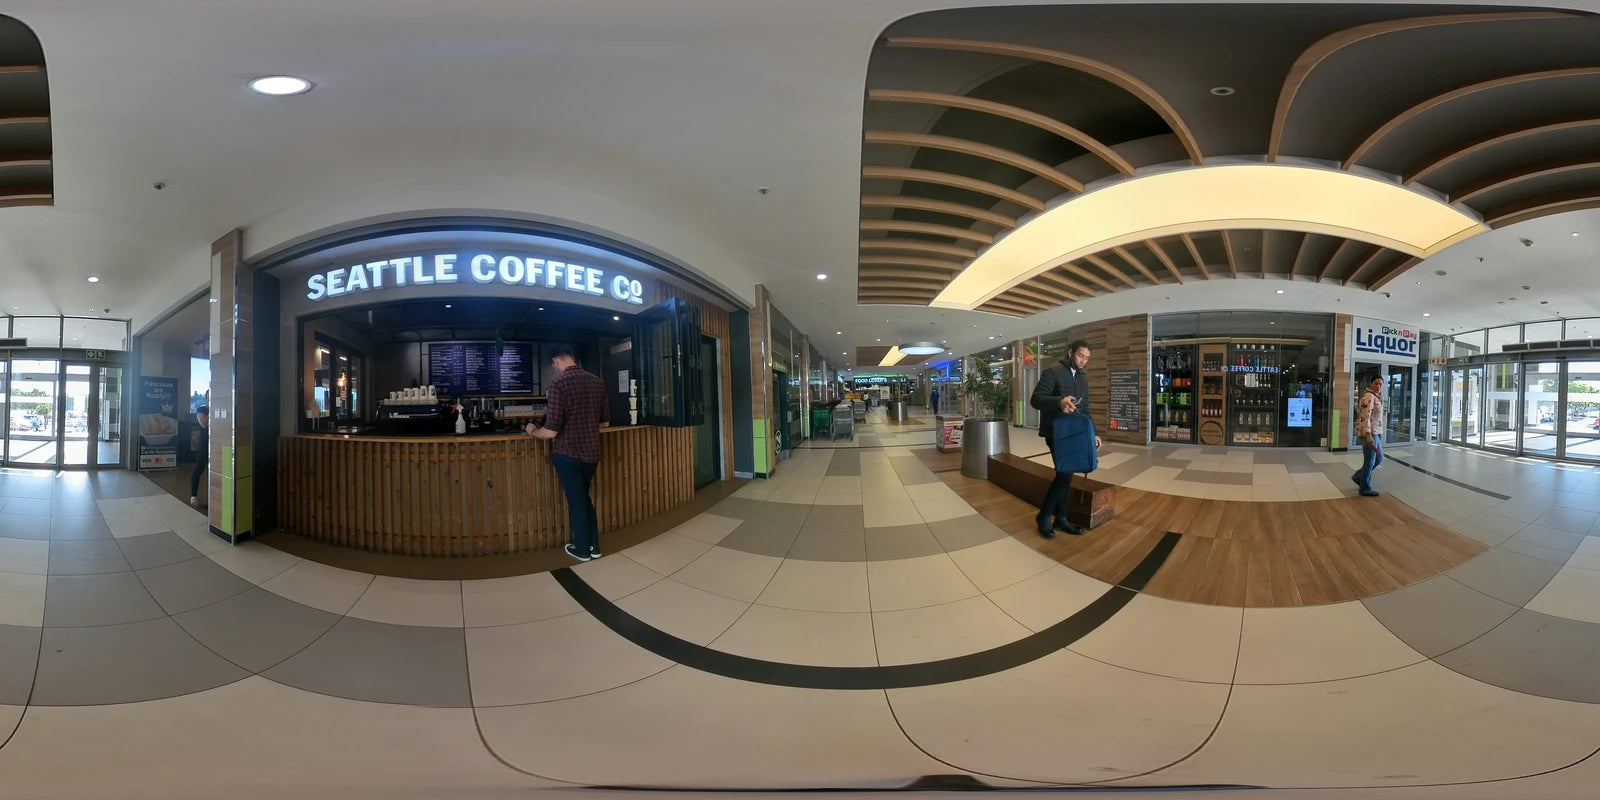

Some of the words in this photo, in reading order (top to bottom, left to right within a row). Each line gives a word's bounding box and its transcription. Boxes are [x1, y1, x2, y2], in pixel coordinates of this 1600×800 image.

[306, 253, 458, 300] SEATTLE
[471, 254, 604, 296] COFFEE
[1356, 327, 1417, 354] Liquor
[1381, 326, 1398, 336] Pick
[1403, 330, 1417, 340] Pay
[144, 380, 174, 388] Pancakes
